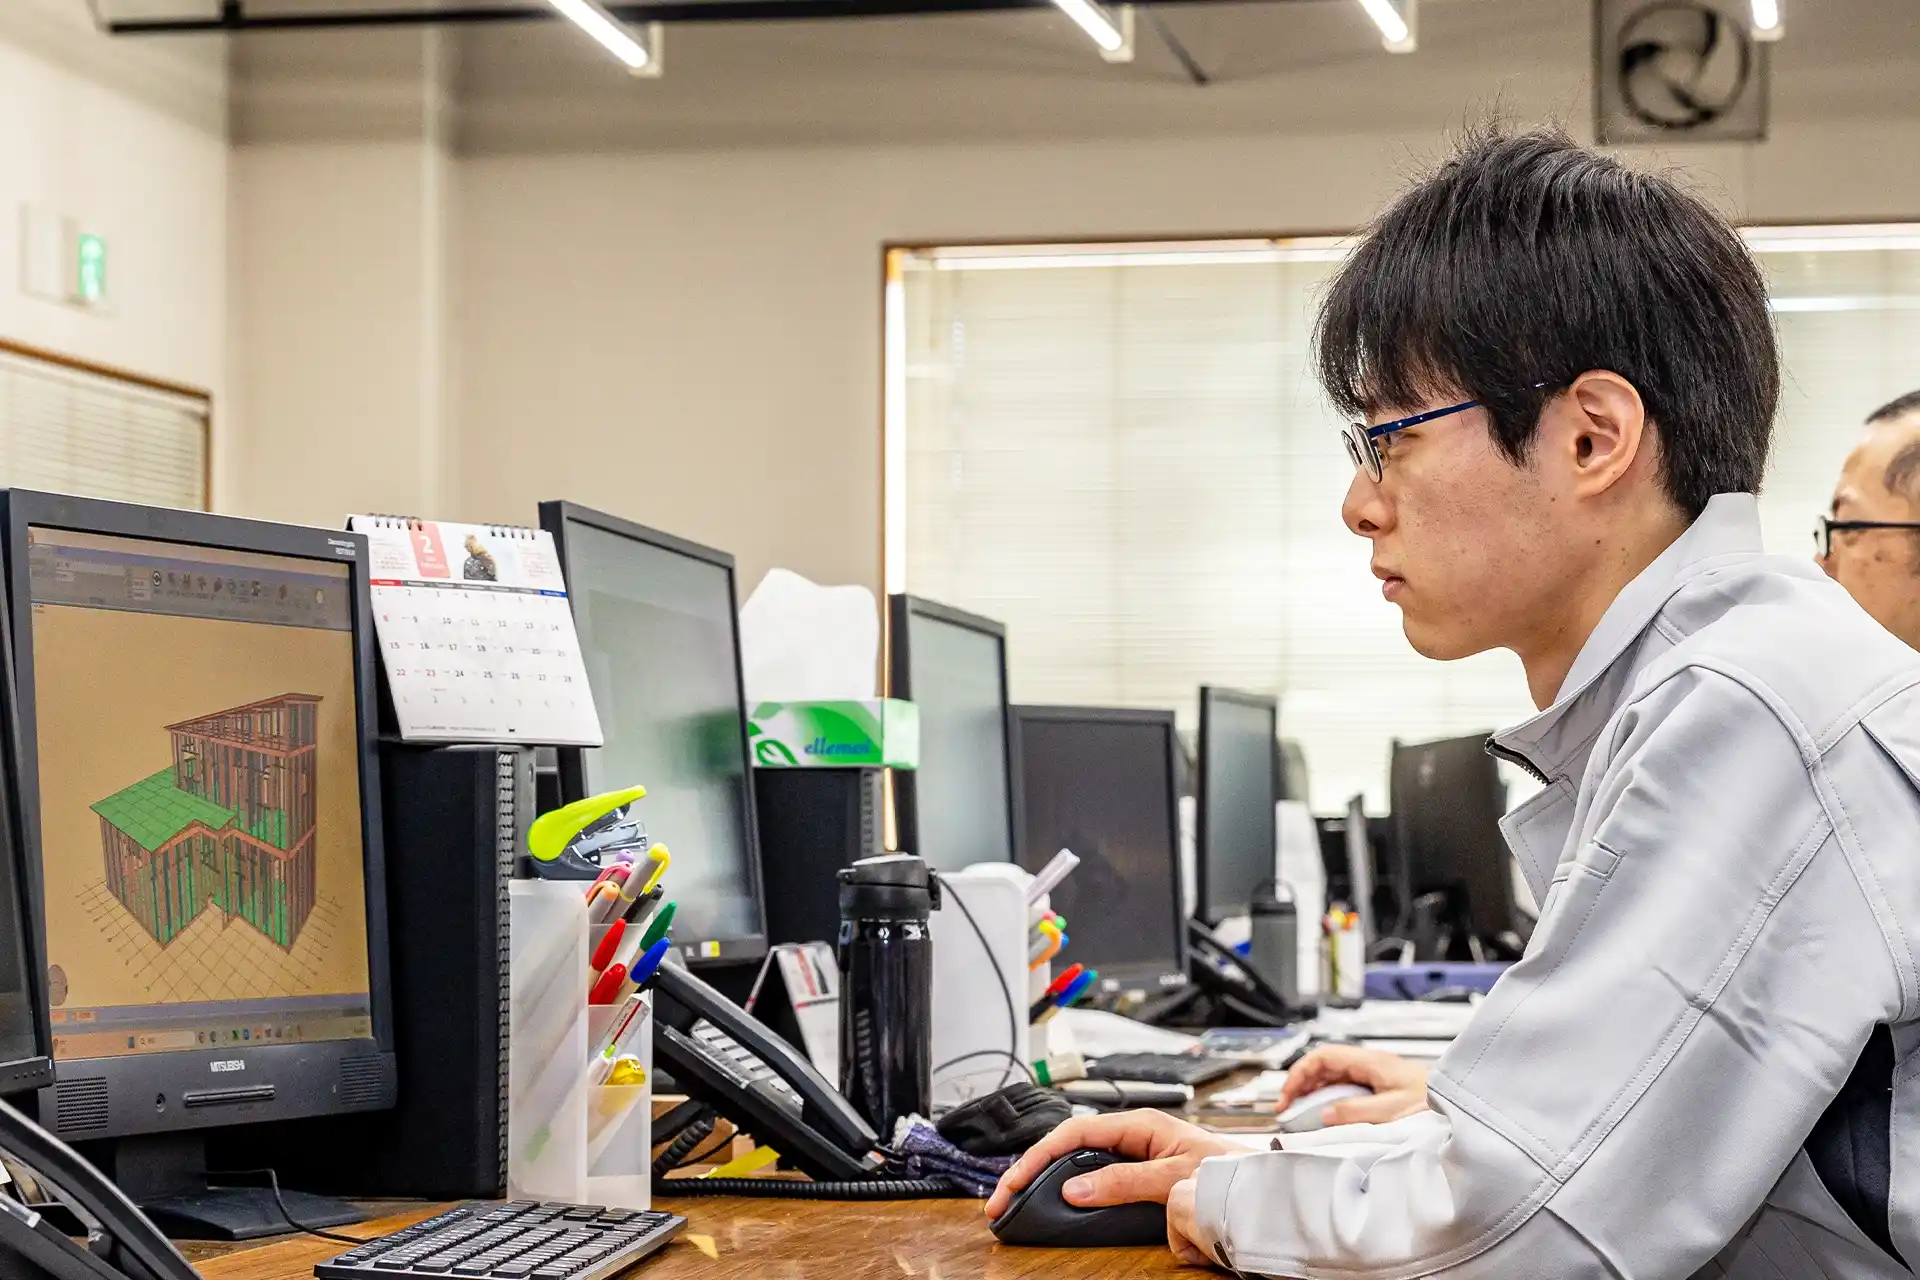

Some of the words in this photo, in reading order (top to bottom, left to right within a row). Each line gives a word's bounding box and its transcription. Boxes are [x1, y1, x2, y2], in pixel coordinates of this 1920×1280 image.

[419, 535, 434, 554] 2
[407, 588, 412, 596] 2
[412, 615, 418, 623] 9
[497, 620, 507, 628] 12
[551, 624, 559, 632] 14
[389, 641, 400, 649] 15
[420, 642, 430, 650] 16
[448, 643, 458, 651] 17
[476, 644, 487, 652] 18
[396, 668, 407, 676] 22
[425, 668, 436, 677] 23
[455, 669, 464, 677] 24
[483, 671, 493, 679] 25
[511, 672, 520, 680] 26
[538, 673, 546, 681] 27
